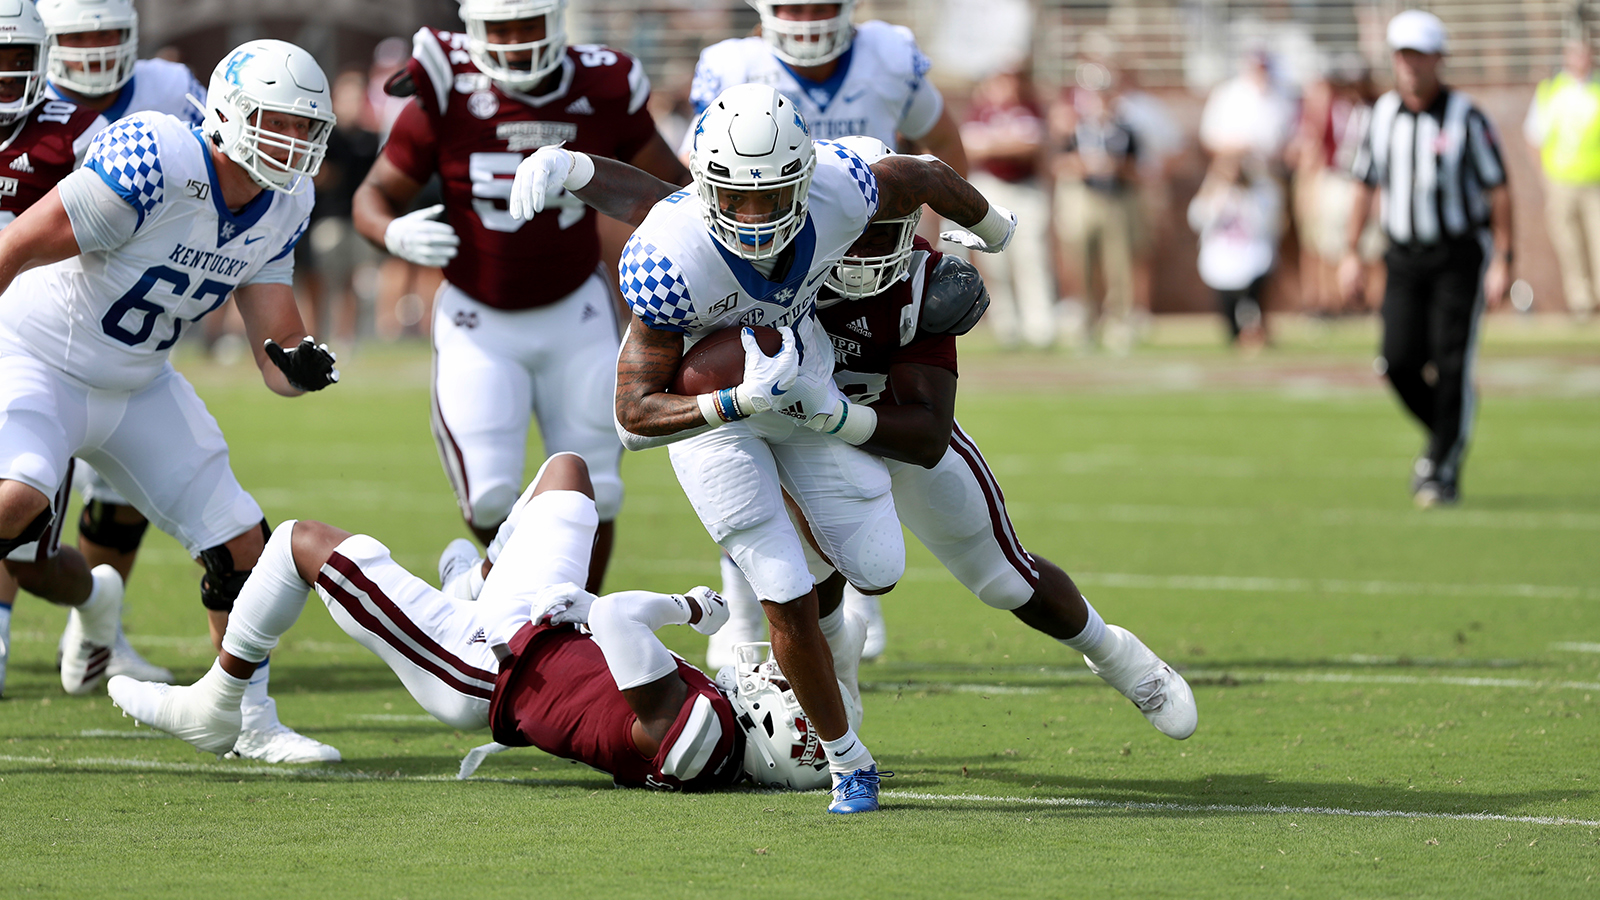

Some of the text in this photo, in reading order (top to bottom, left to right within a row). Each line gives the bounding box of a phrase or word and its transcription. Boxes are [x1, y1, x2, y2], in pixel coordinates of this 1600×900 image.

[37, 101, 77, 125] 10
[185, 179, 210, 200] 150
[168, 243, 248, 278] KENTUCKY
[101, 264, 236, 351] 67
[707, 291, 739, 317] 150
[740, 309, 763, 326] SEC
[845, 323, 873, 338] adidas
[803, 721, 818, 757] STATE
